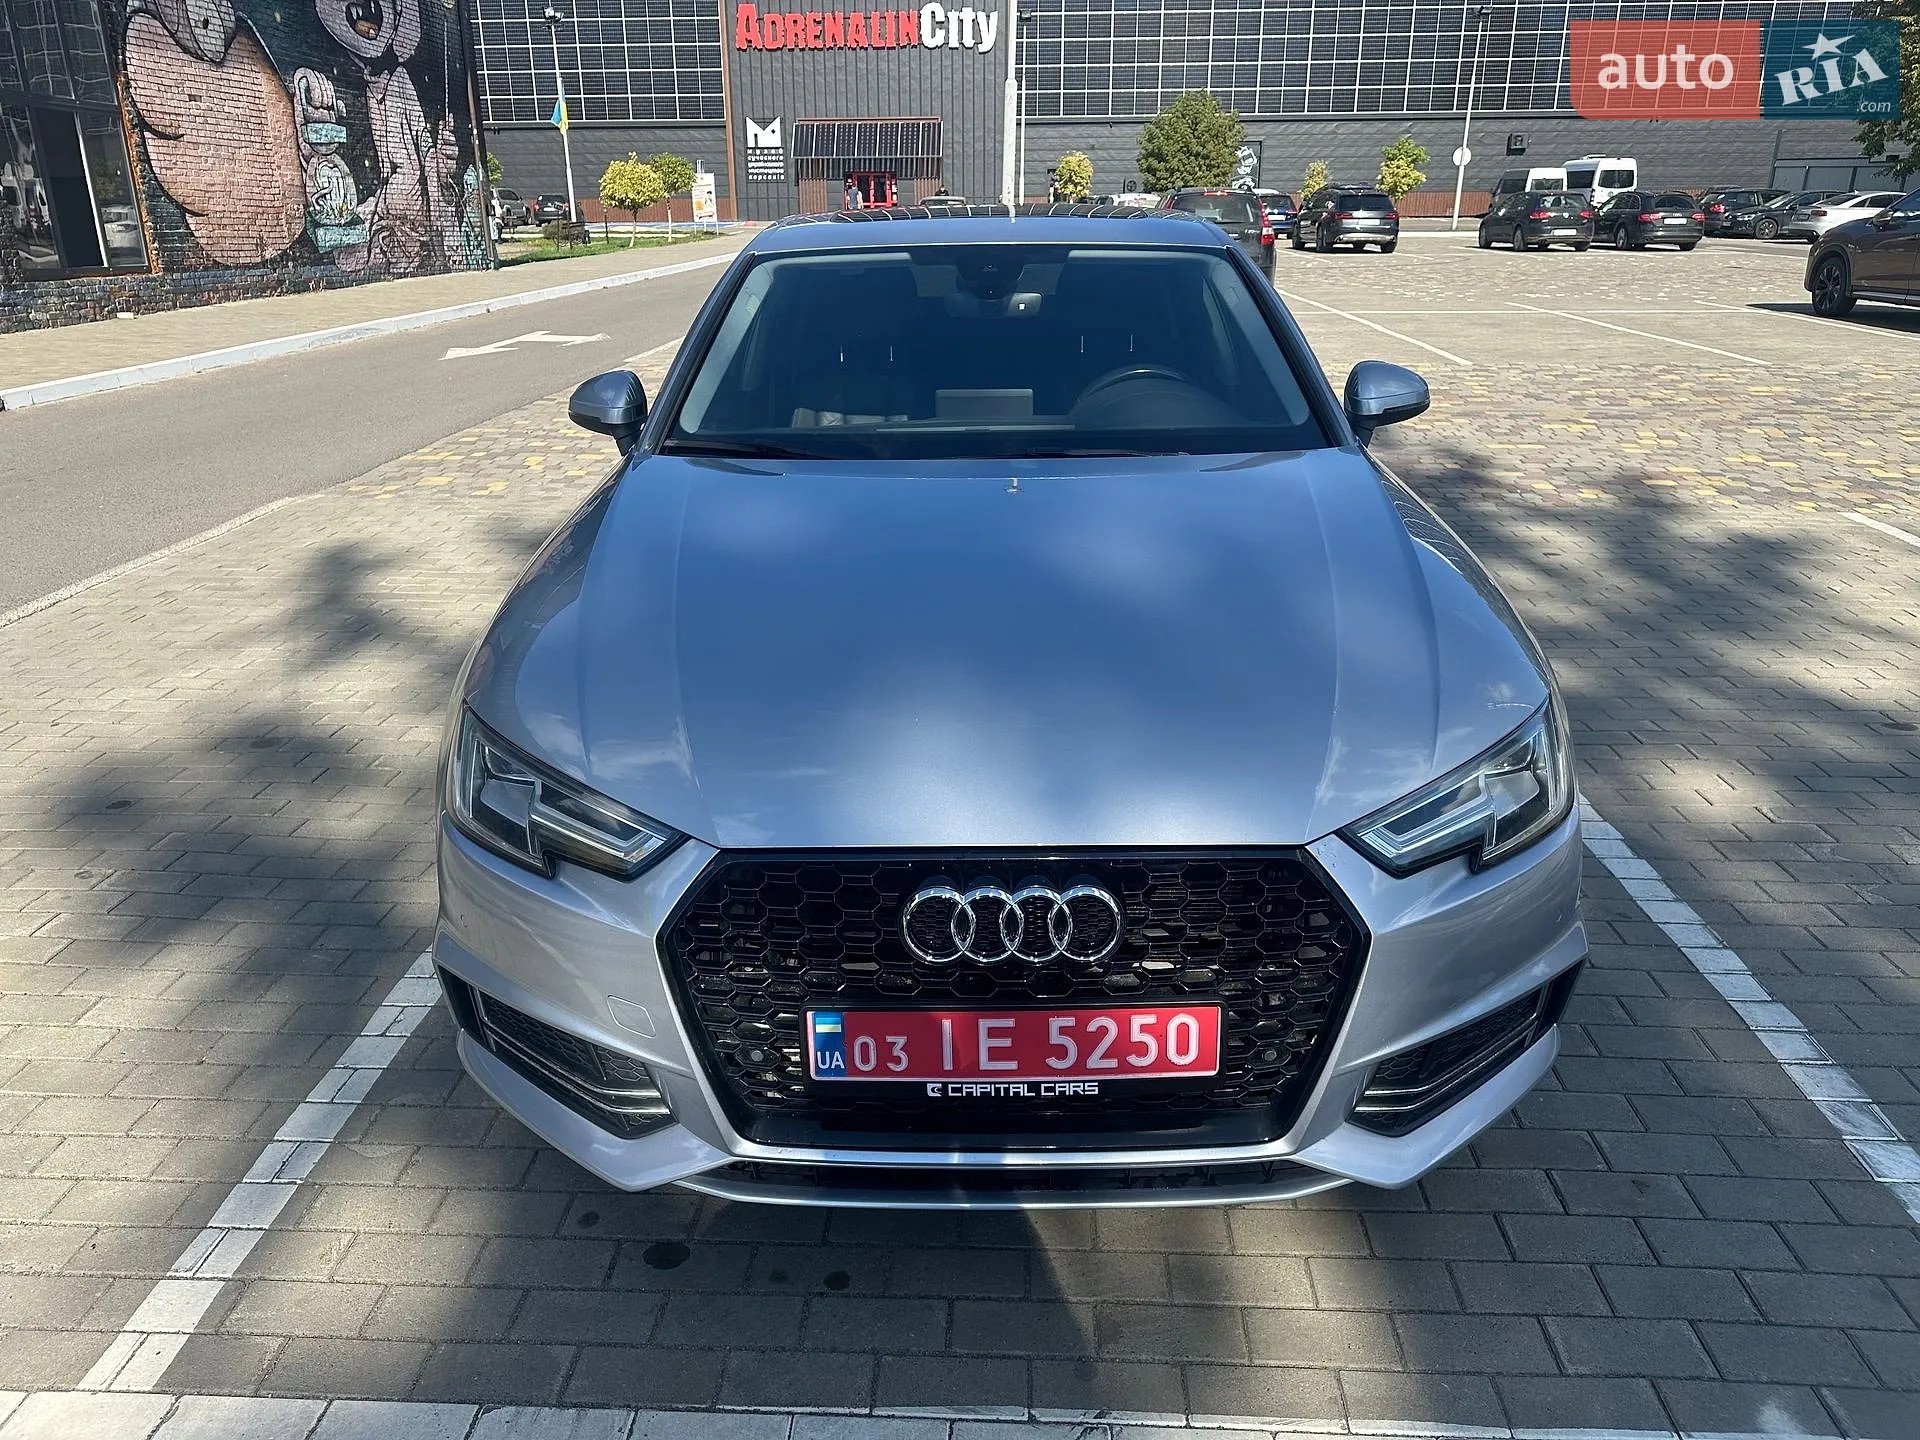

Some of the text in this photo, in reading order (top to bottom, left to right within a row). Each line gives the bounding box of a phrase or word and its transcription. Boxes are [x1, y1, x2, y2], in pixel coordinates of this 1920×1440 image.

[816, 1013, 1200, 1072] UA 03 IE 5250
[948, 1082, 1099, 1097] CAPITAL CARS
